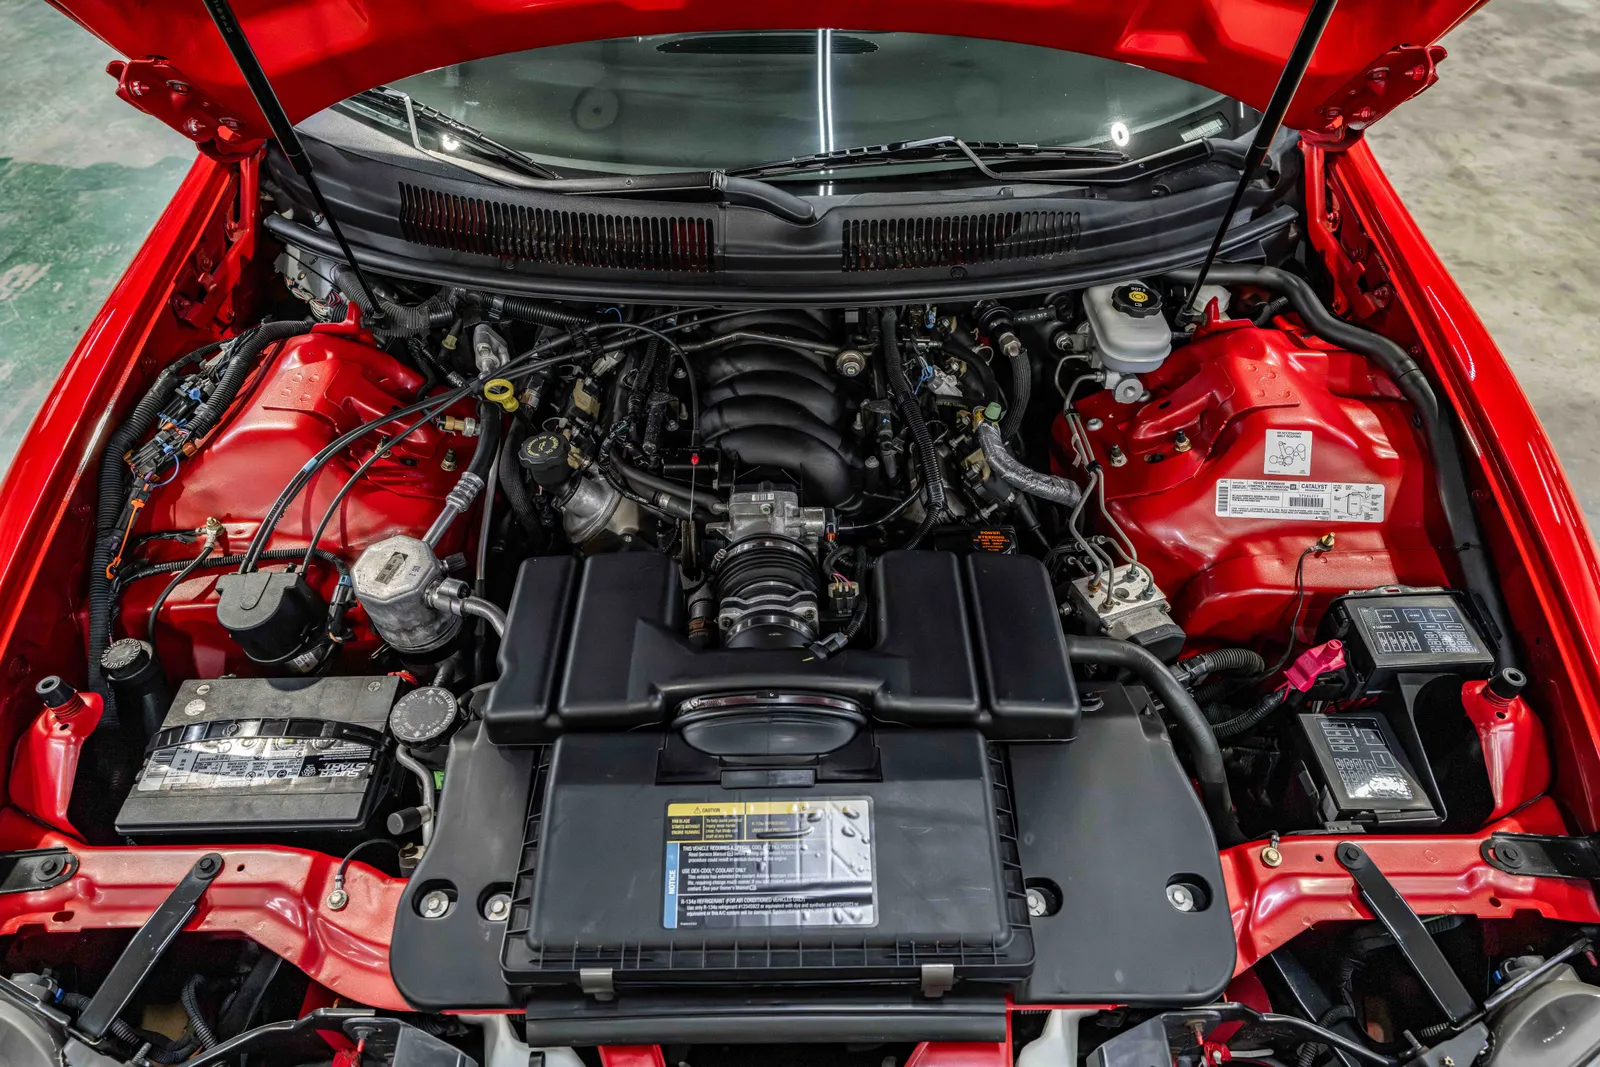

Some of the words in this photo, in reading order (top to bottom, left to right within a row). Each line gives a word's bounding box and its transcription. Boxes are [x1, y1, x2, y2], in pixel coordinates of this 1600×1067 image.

[100, 640, 122, 662] ENGINE
[318, 770, 358, 778] SUPER
[325, 762, 368, 771] START
[668, 870, 676, 894] NOTICE
